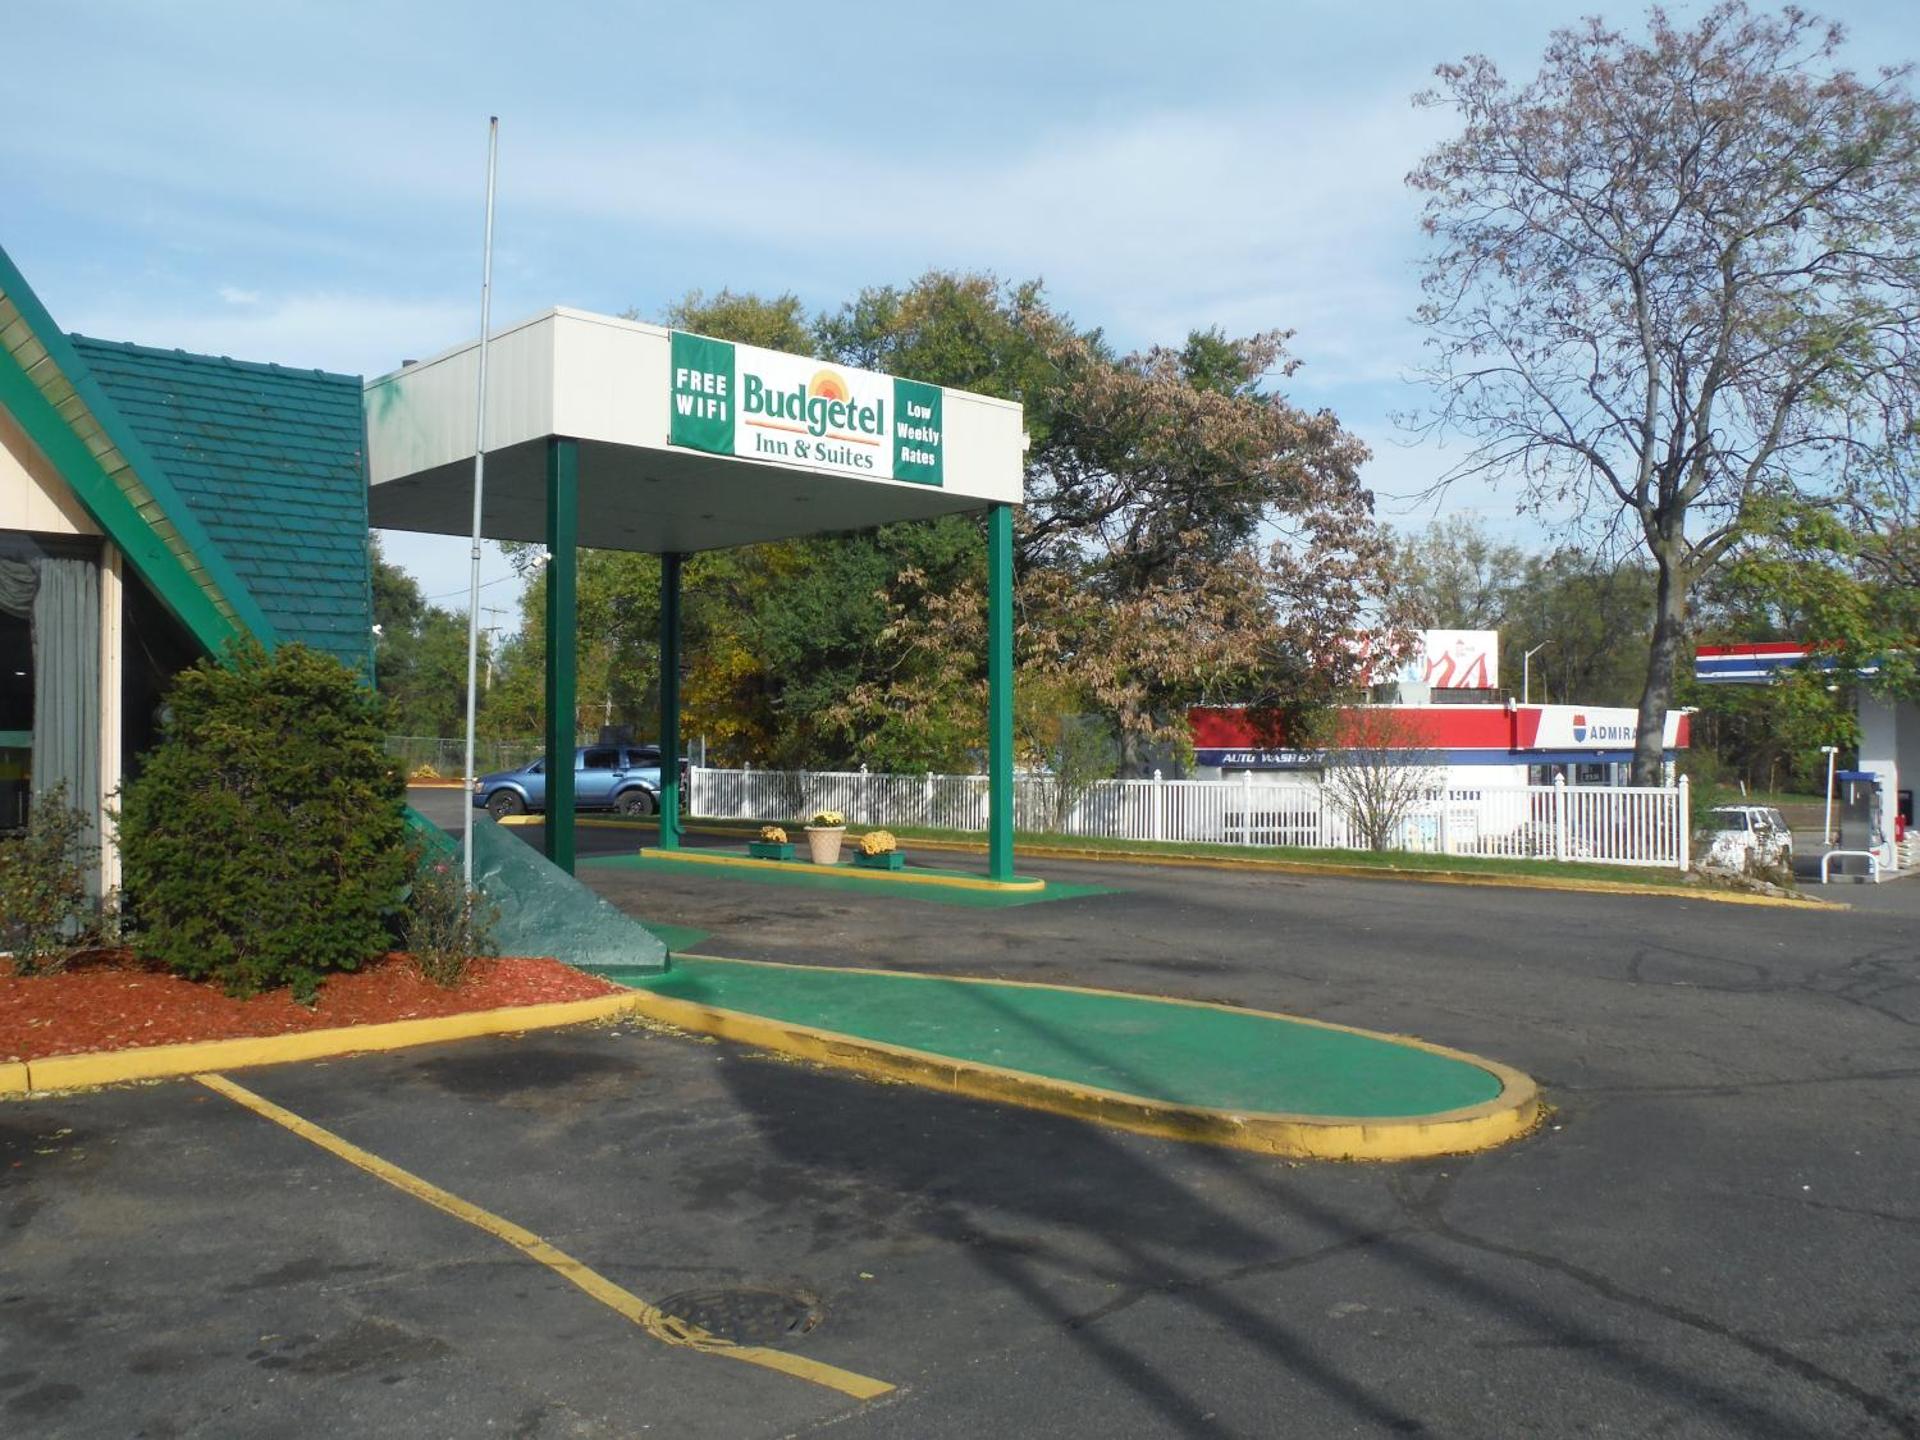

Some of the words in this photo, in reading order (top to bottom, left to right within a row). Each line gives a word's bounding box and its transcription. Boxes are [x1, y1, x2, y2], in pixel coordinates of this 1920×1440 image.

[676, 368, 727, 397] FREE
[676, 394, 727, 421] WIFI
[743, 373, 884, 437] Budgetel
[906, 400, 932, 420] Low
[896, 422, 940, 447] Weekly
[755, 432, 789, 456] Inn
[794, 440, 811, 459] &
[815, 442, 874, 470] Suites
[901, 446, 935, 466] Rates
[1590, 726, 1638, 740] ADMIRA
[1222, 753, 1256, 763] AUTO
[1261, 753, 1297, 763] WASH
